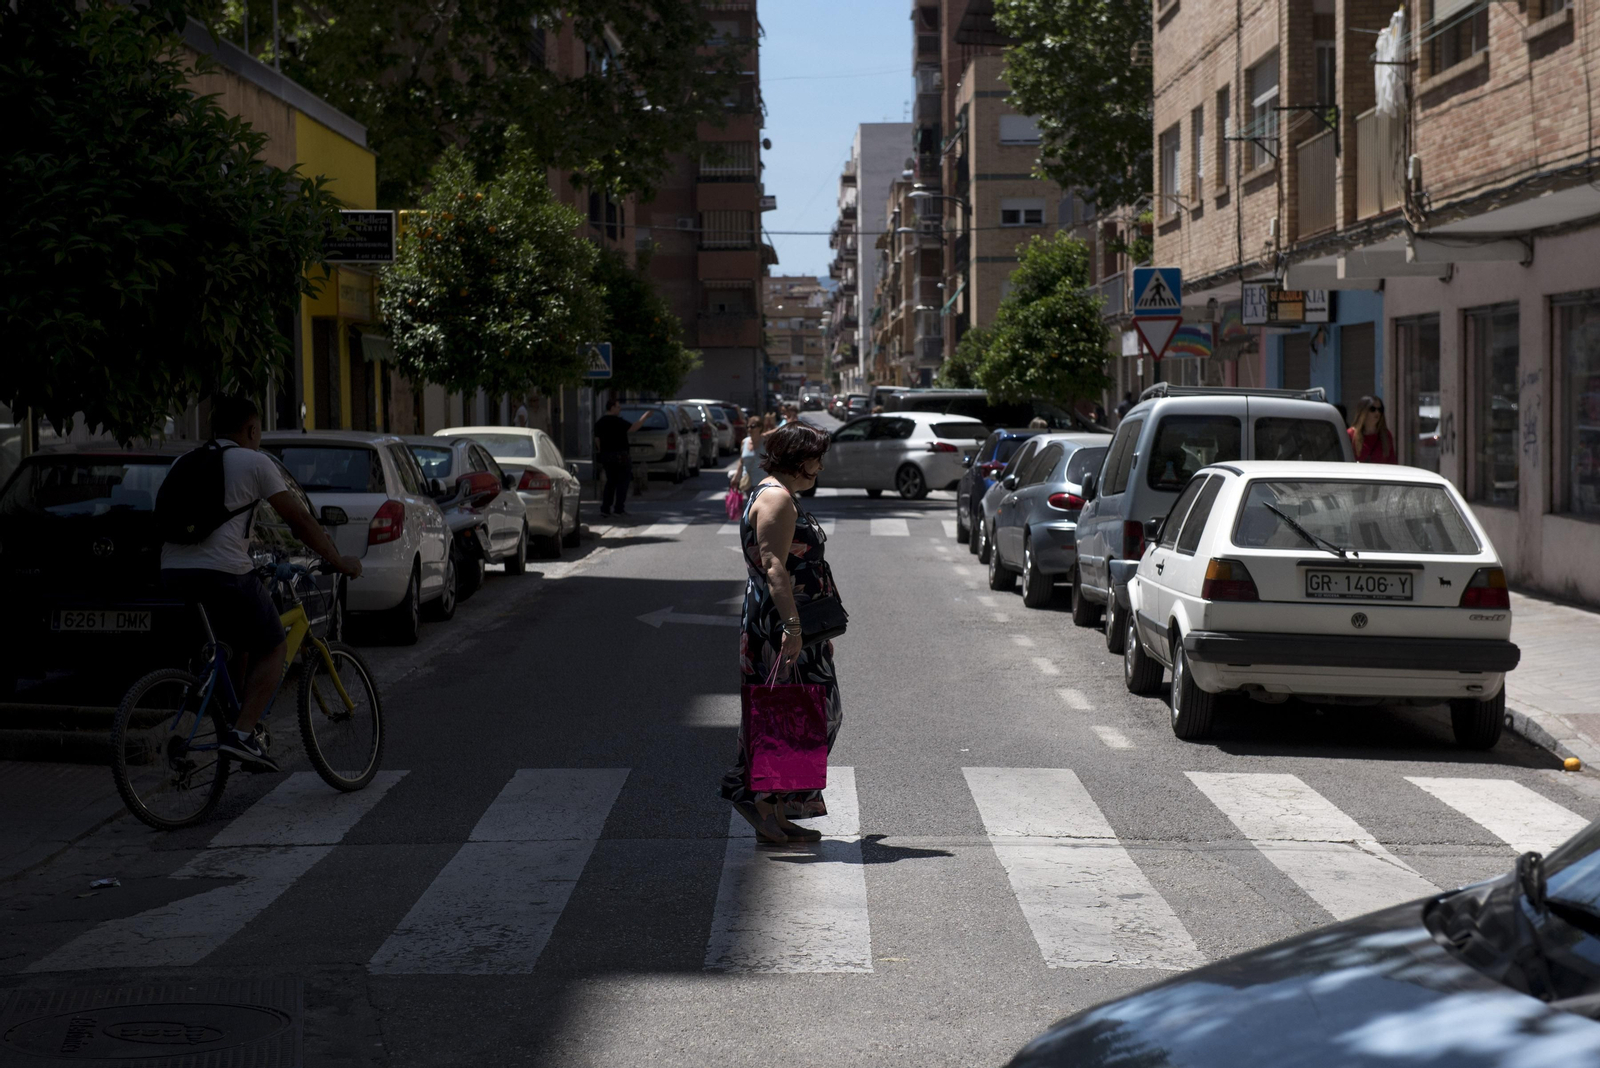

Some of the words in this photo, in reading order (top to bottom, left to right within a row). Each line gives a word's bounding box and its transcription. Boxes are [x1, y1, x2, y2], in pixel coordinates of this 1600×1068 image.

[358, 214, 388, 224] Belleza
[1244, 305, 1258, 318] LA
[64, 612, 106, 628] 6261
[116, 612, 149, 628] DMK
[1469, 614, 1506, 622] Golf
